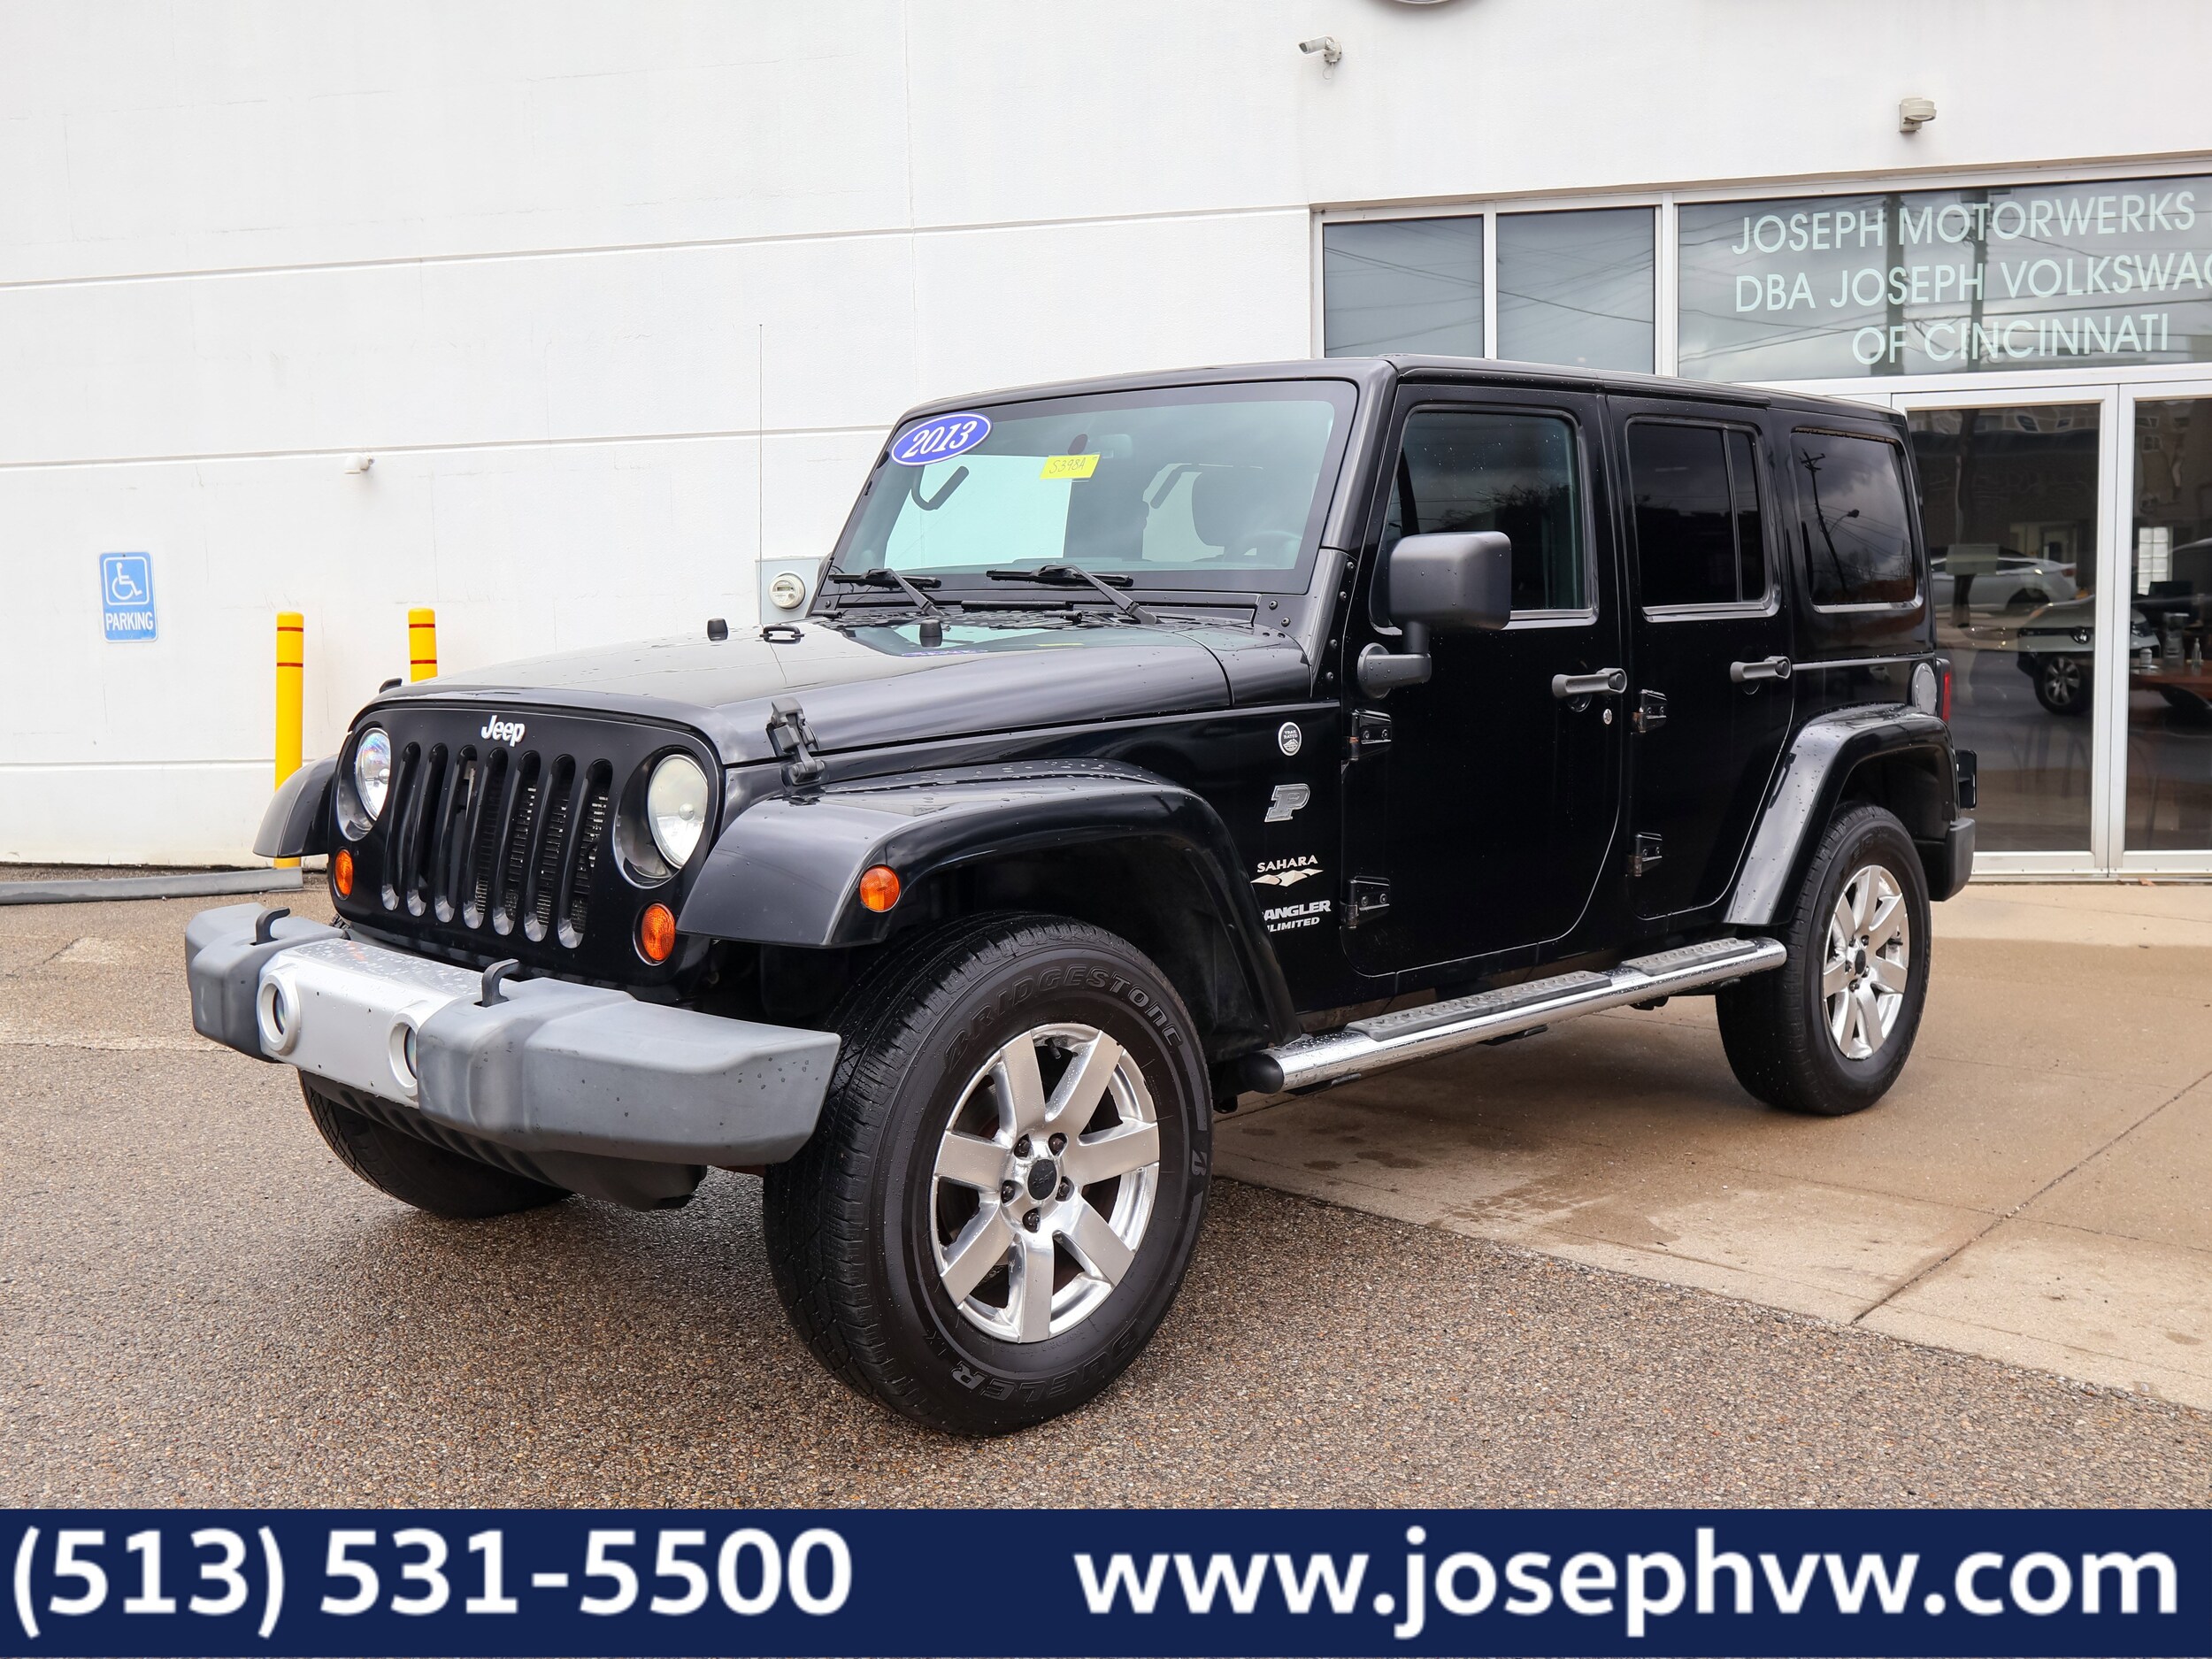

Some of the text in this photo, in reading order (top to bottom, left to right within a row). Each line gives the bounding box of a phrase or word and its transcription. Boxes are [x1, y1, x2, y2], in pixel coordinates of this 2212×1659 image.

[1732, 190, 2196, 256] JOSEPH MOTORWERKS
[1735, 251, 2212, 313] DBA JOSEPH VOLKSWA
[1852, 312, 2170, 366] OF CINCINNATI
[901, 420, 979, 459] 2013
[105, 611, 154, 631] PARKING
[480, 714, 526, 748] Jeep
[1256, 854, 1318, 873] SAHARA
[1262, 900, 1332, 921] ANGLER
[1266, 917, 1320, 933] LIMITED
